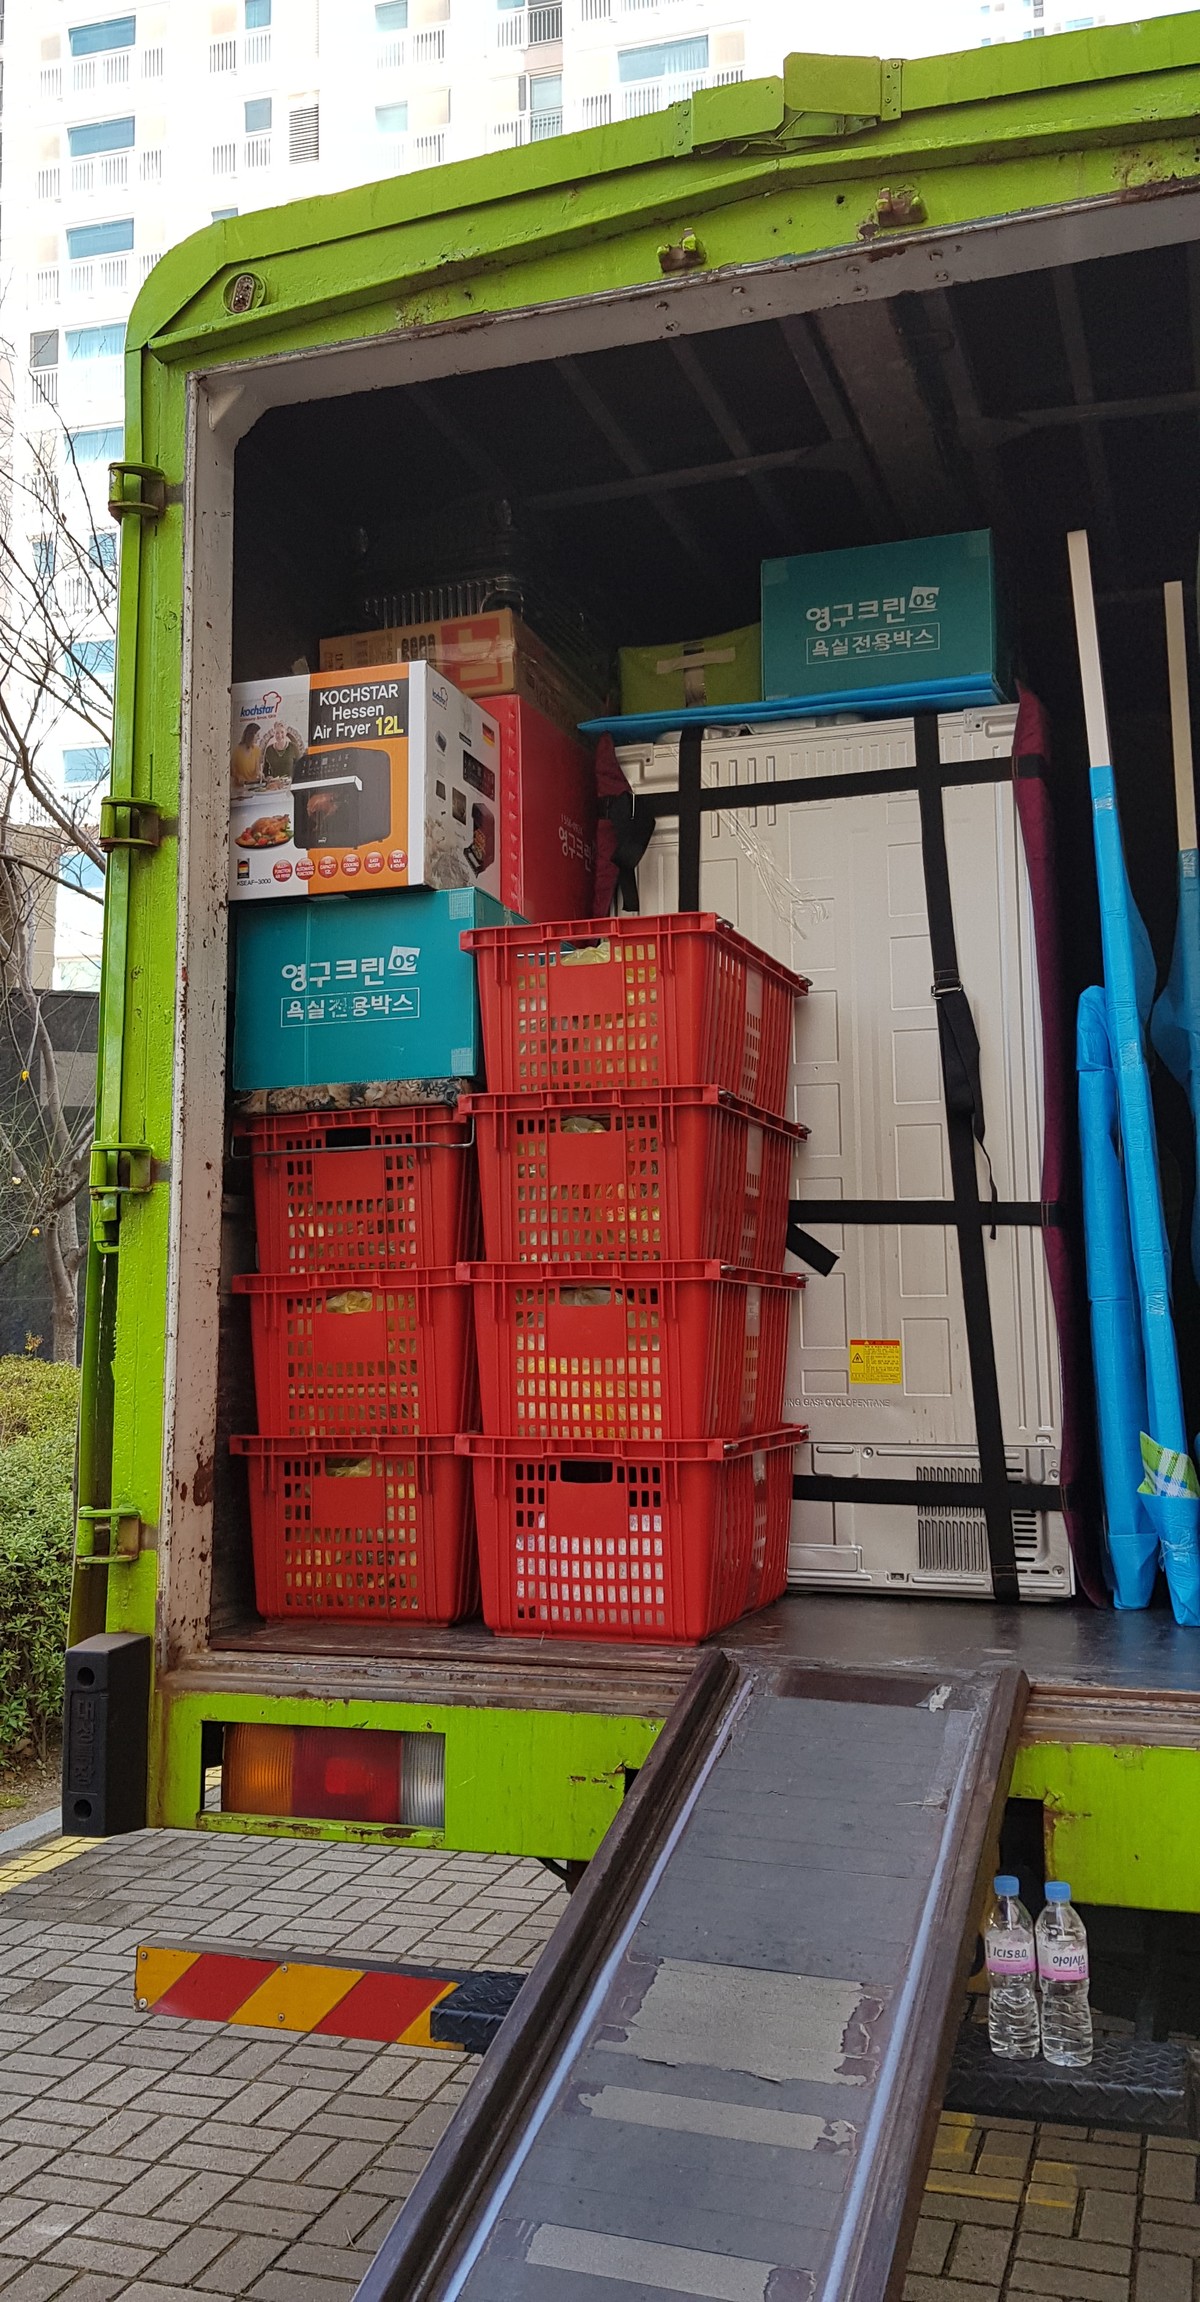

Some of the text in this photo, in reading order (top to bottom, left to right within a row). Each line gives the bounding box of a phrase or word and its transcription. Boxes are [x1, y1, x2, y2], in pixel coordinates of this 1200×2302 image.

[805, 597, 906, 632] 영구크린
[811, 628, 936, 658] 욕실전용박스
[319, 683, 399, 707] KOCHSTAR
[239, 704, 275, 718] kochstar
[332, 704, 385, 721] Hessen
[312, 715, 405, 740] Air Fryer 12L
[281, 954, 418, 992] 영구크린 09
[286, 994, 414, 1020] 욕실전용박스
[825, 1398, 890, 1408] CYCLOPENTANE
